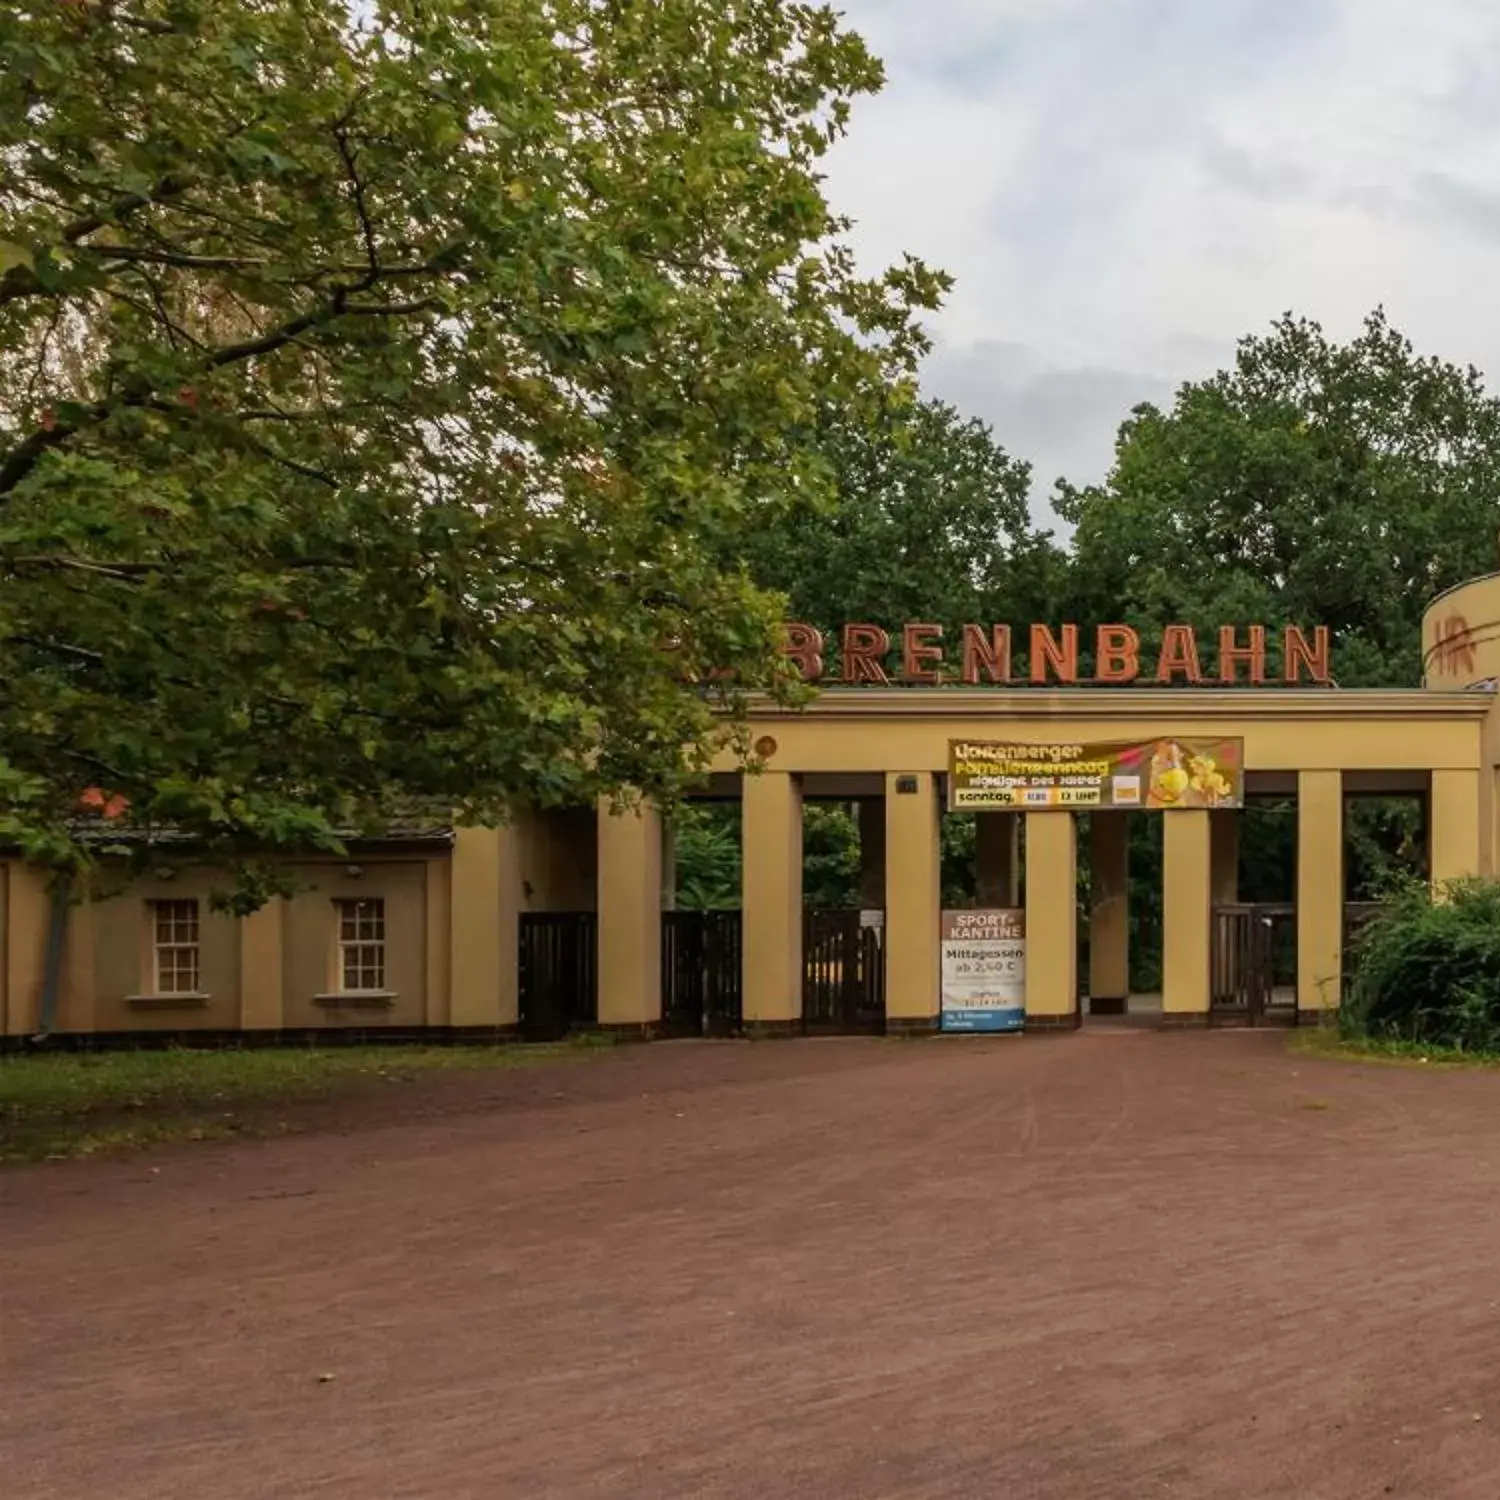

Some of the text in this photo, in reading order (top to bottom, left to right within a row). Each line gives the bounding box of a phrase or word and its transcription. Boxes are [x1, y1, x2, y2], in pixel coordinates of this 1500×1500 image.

[700, 622, 1329, 684] BRENNBAHN
[957, 914, 1016, 927] SPORT-
[951, 926, 1021, 938] KANTINE
[947, 949, 1024, 961] Mittagessen
